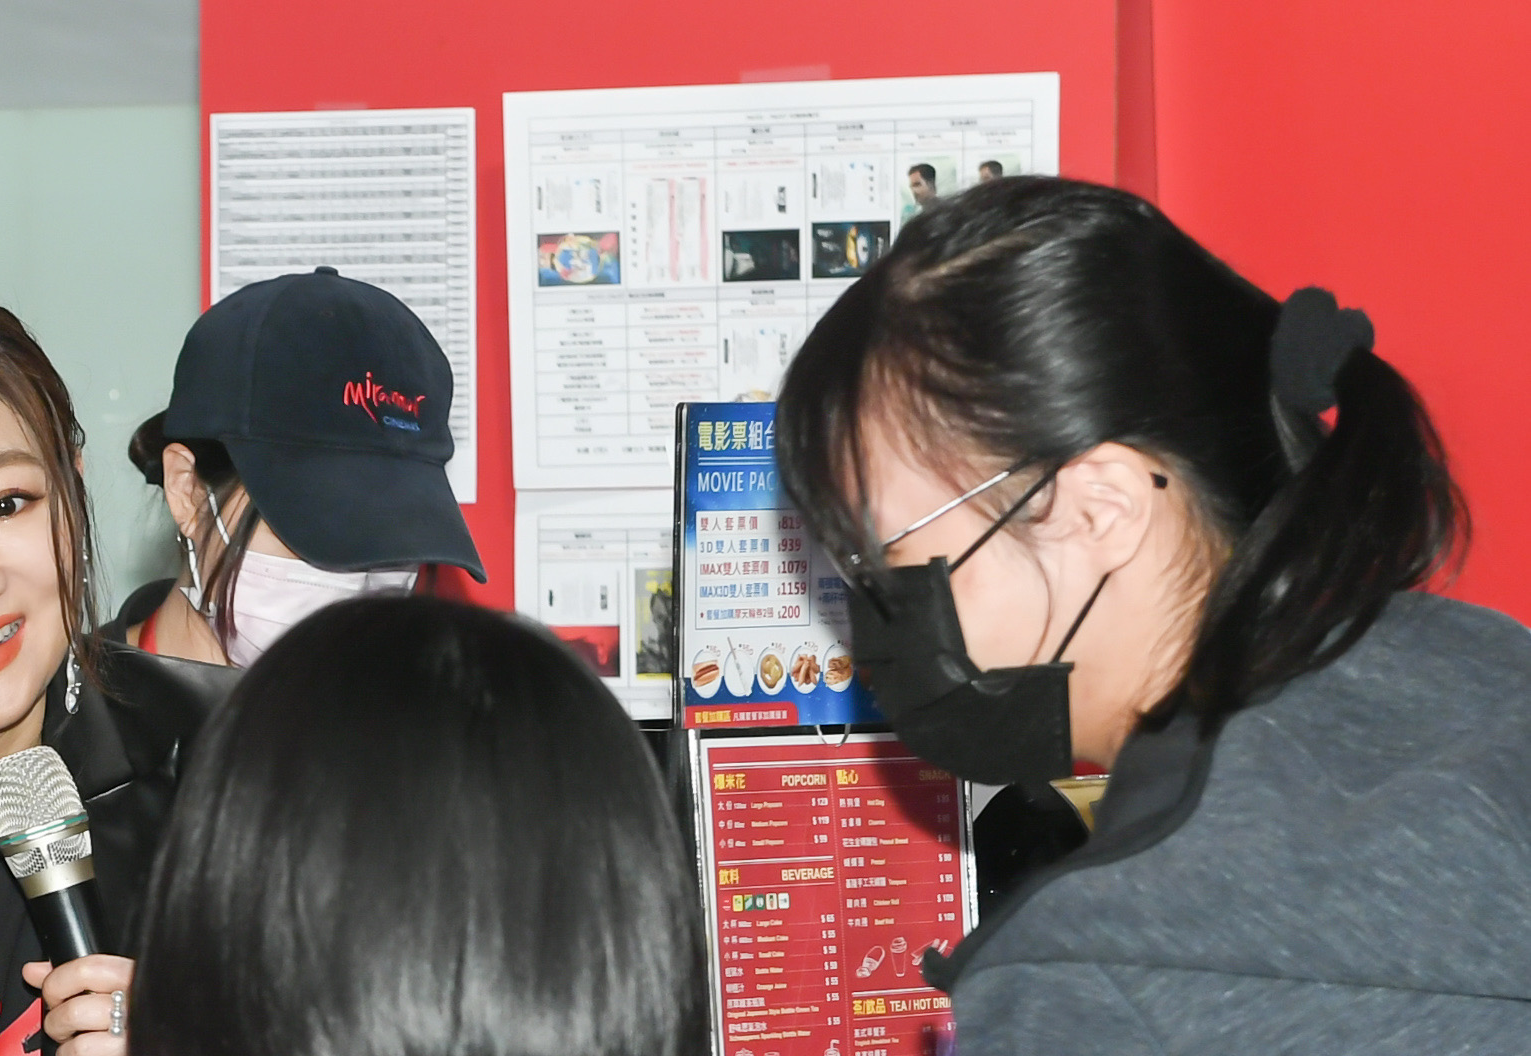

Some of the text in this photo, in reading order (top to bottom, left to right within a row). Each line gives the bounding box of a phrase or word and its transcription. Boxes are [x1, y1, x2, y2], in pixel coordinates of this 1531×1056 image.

[698, 471, 744, 492] MOVIE
[777, 560, 807, 574] $1079
[777, 582, 807, 596] $1159
[778, 605, 800, 619] $200
[714, 773, 827, 790] 爆米花 POPCORN
[781, 867, 835, 881] BEVERAGE
[890, 1000, 907, 1012] TEA
[913, 998, 931, 1010] HOT
